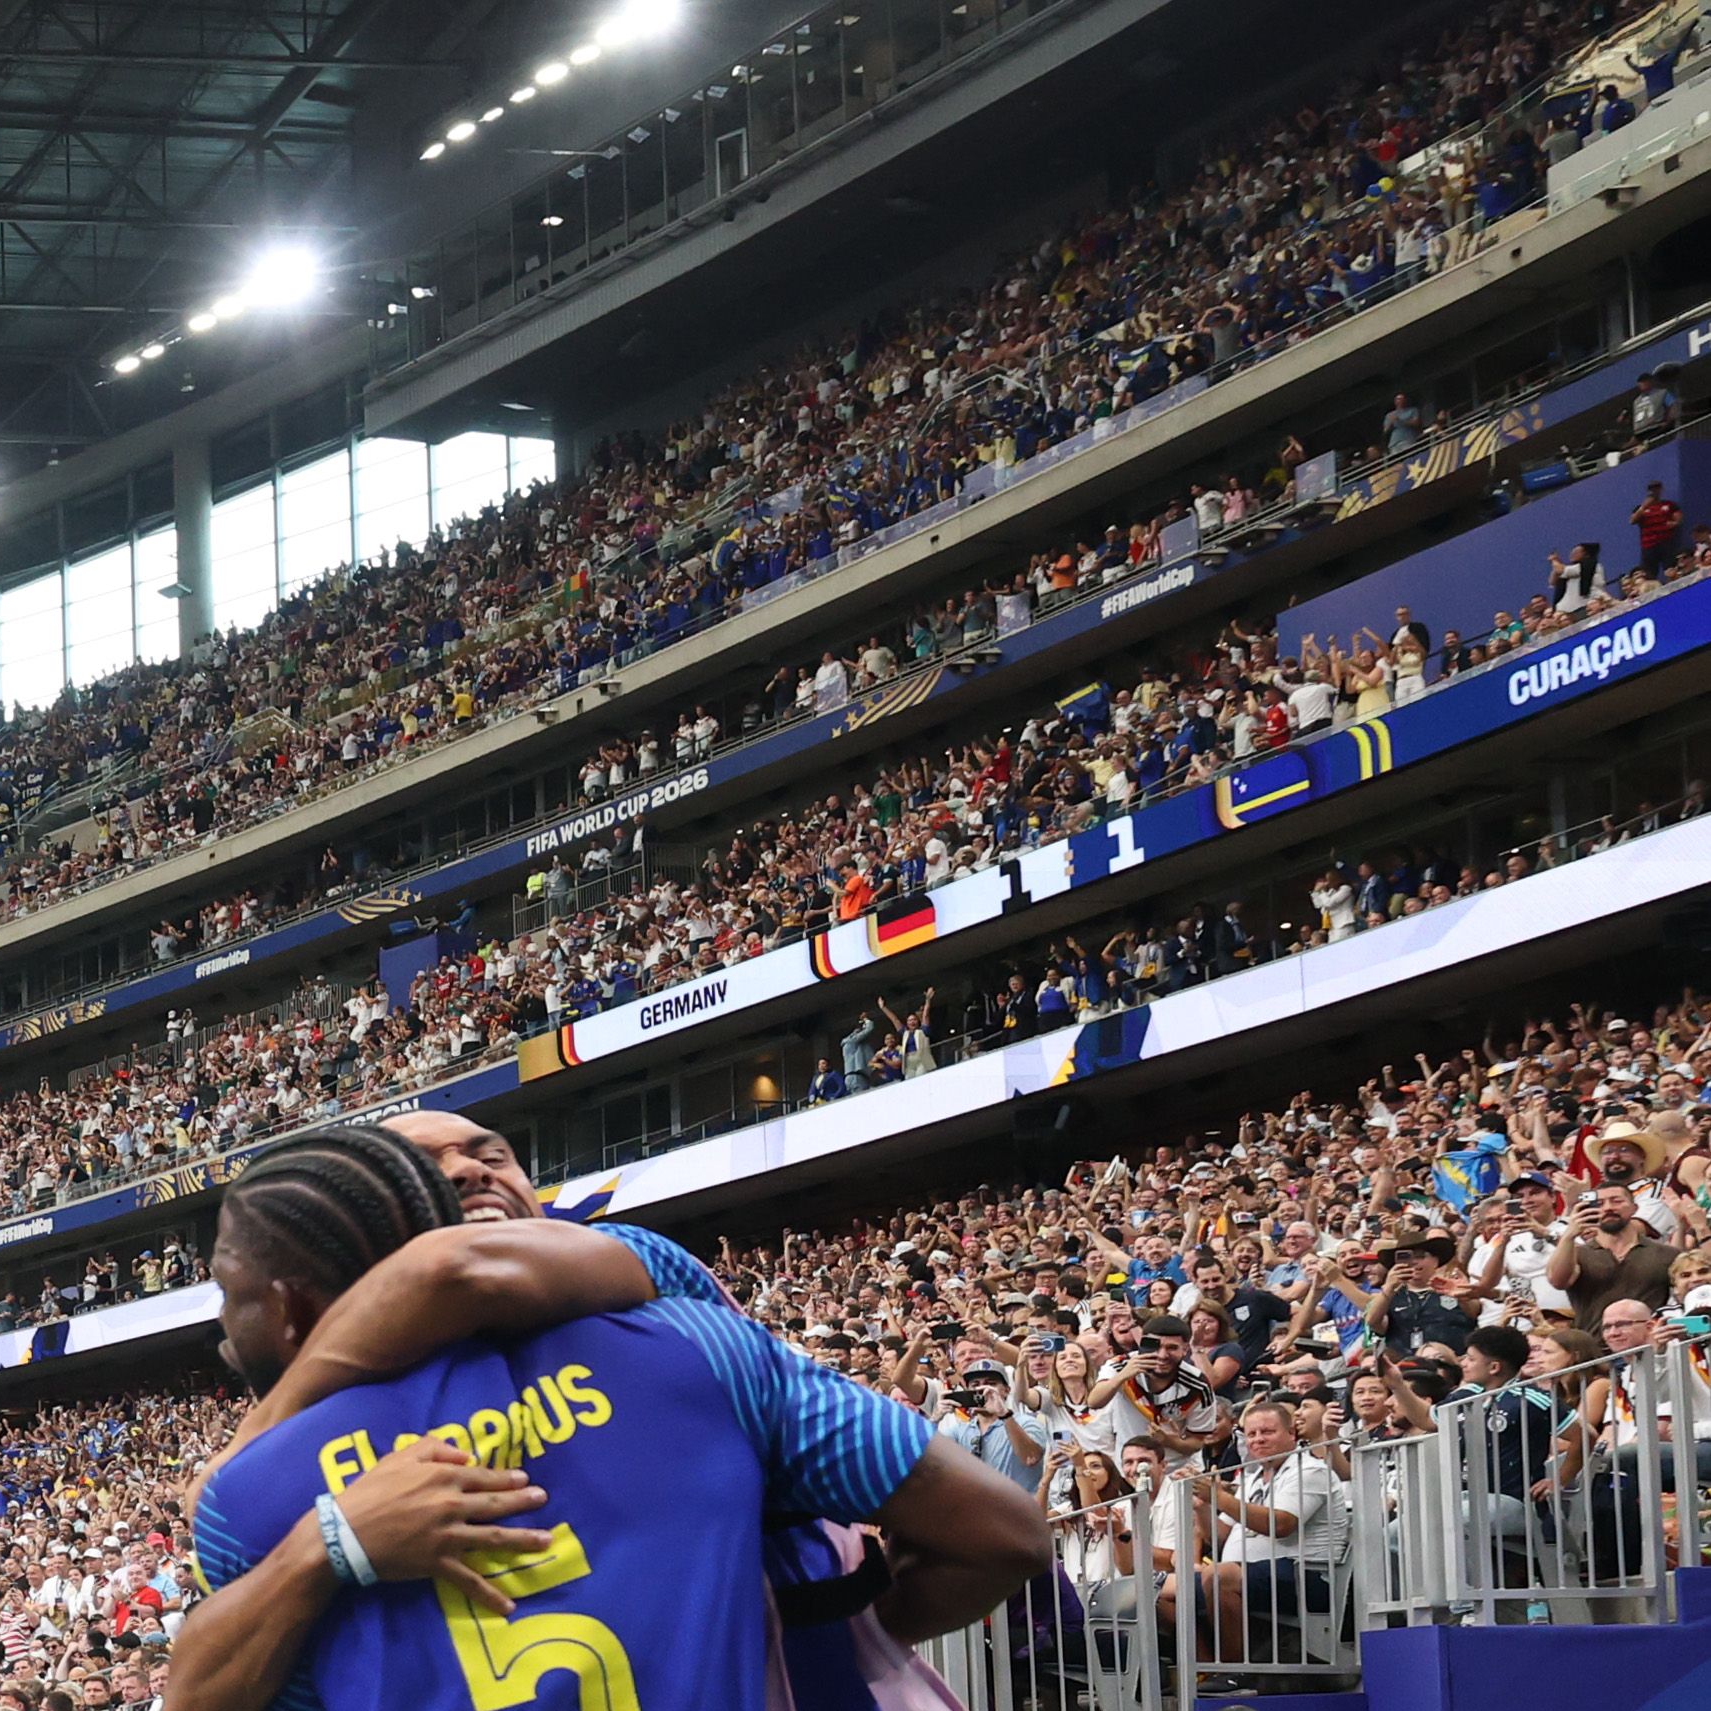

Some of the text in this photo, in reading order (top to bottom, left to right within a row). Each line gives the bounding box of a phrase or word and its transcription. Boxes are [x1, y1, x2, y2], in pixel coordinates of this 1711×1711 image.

[1508, 618, 1656, 706] CURAÇAO
[527, 768, 709, 857] FIFA WORLD CUP 2026
[640, 815, 1145, 1030] GERMANY 1 1
